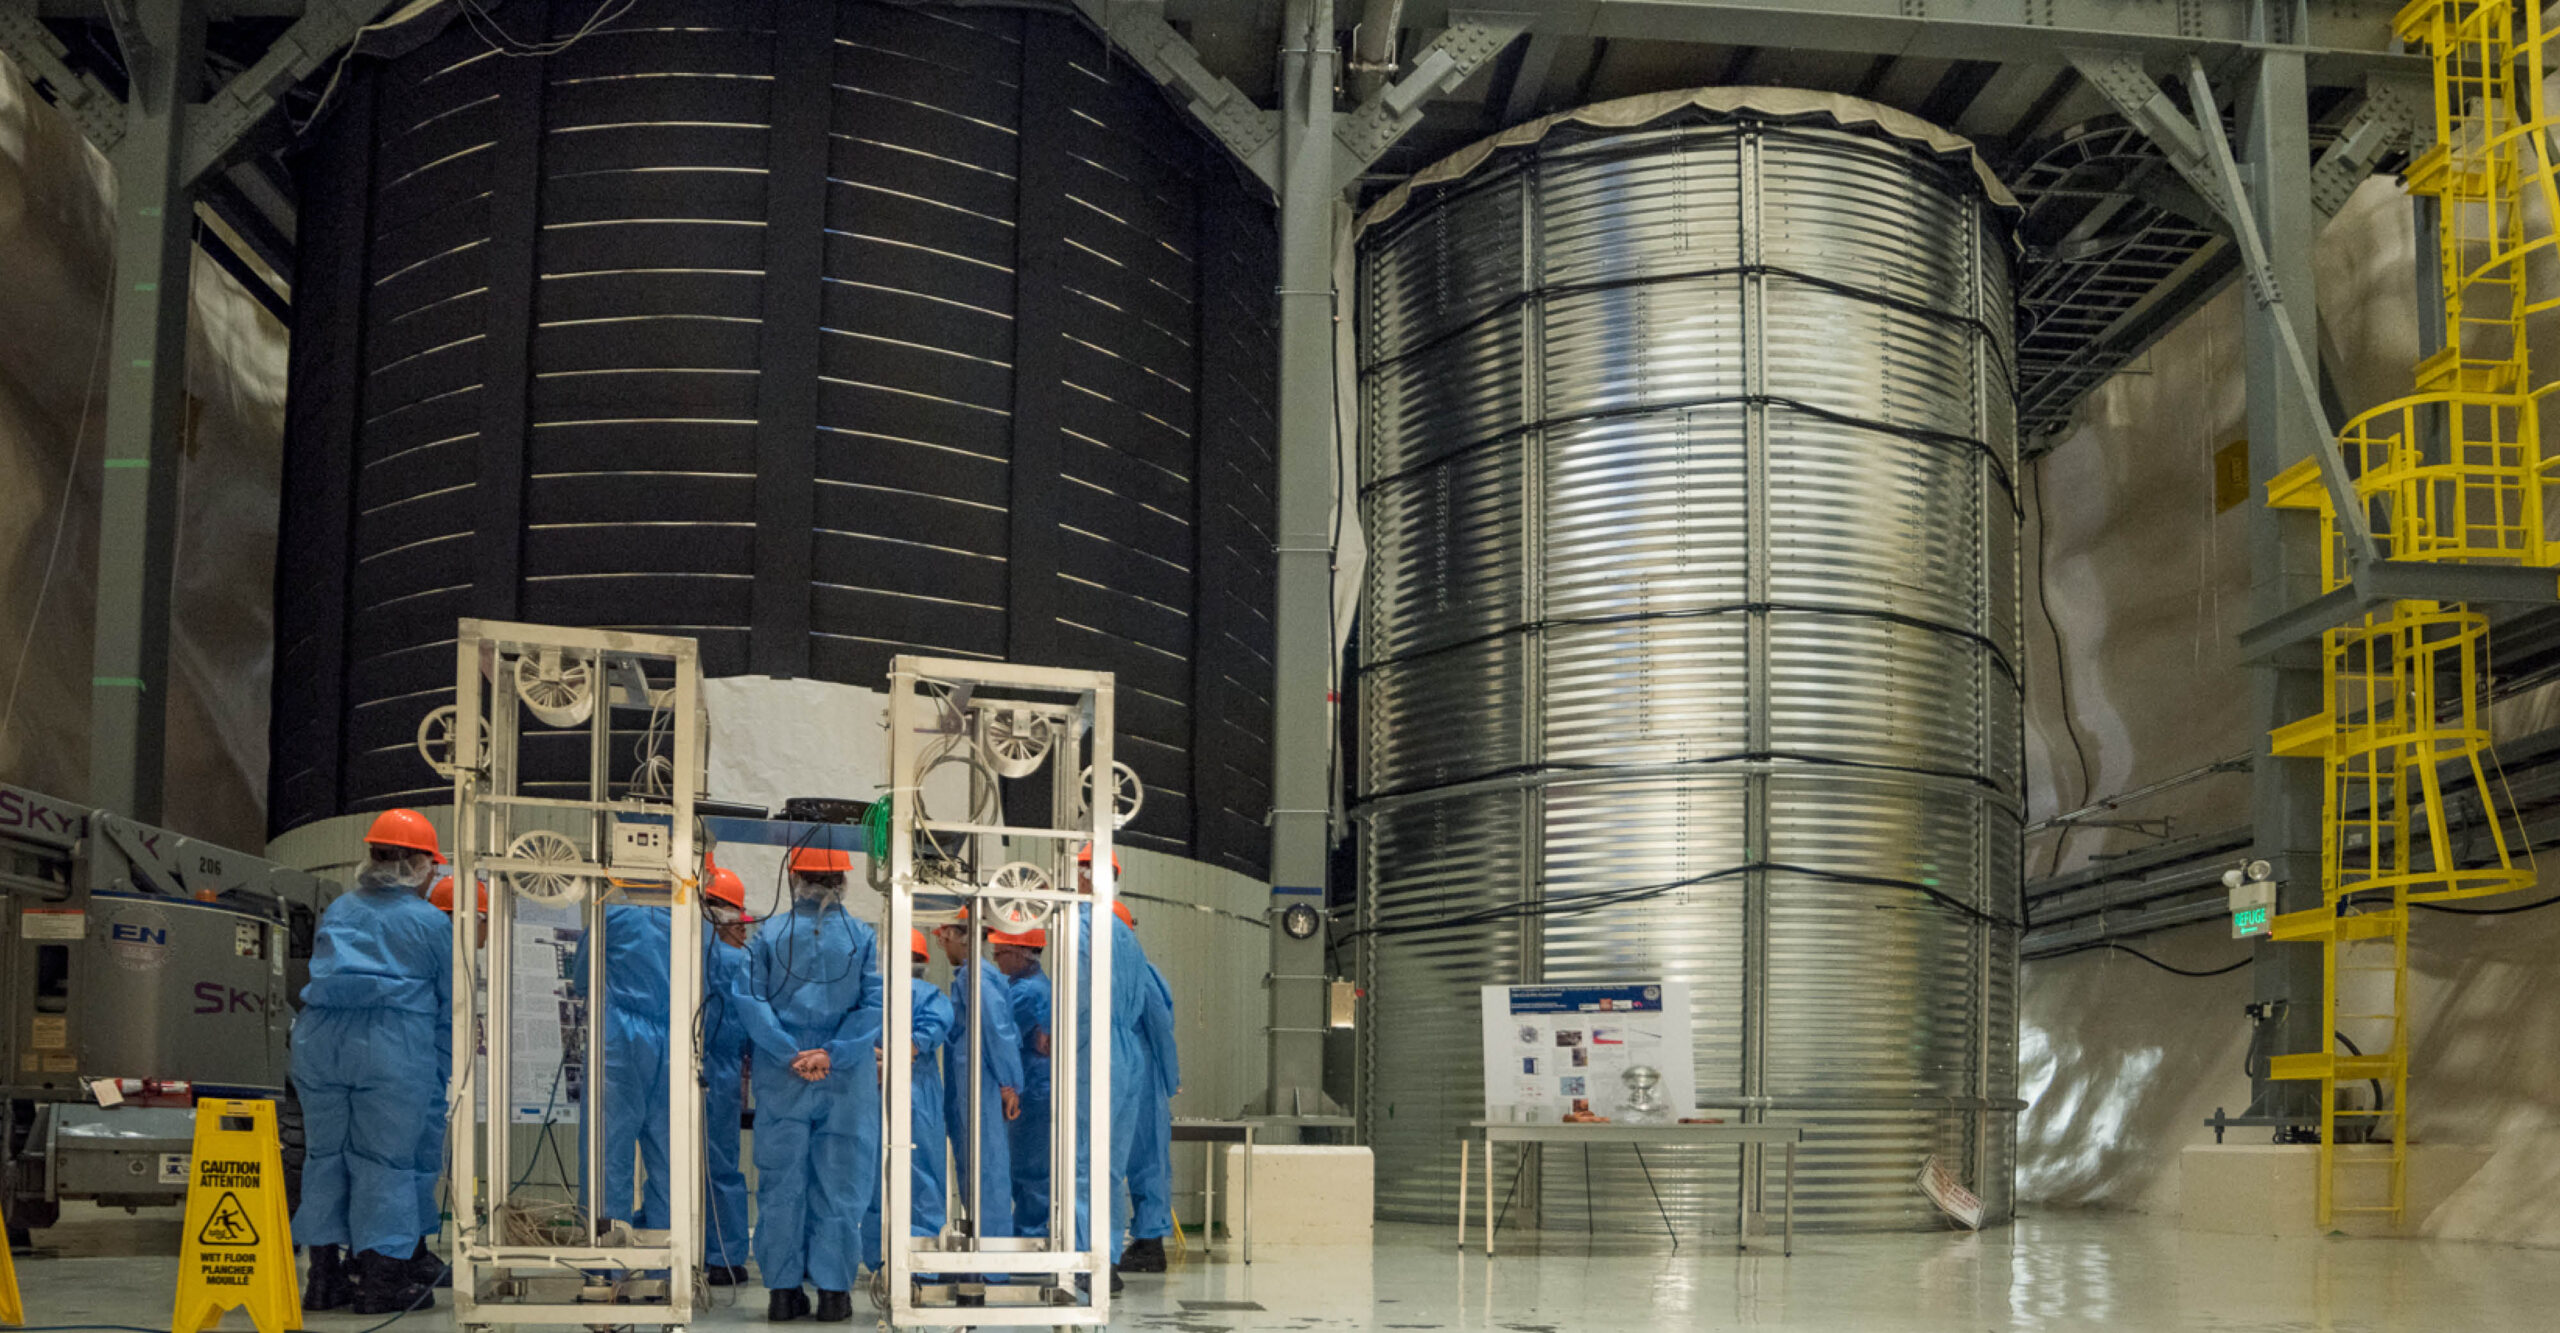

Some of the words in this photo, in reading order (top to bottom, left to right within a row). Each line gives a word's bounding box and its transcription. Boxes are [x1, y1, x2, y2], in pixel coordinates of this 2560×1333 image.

[199, 856, 222, 876] 206
[2234, 908, 2266, 926] REFUGE
[112, 923, 166, 945] EN
[200, 1160, 261, 1175] CAUTION
[200, 1175, 260, 1189] ATTENTION
[200, 1252, 221, 1263] WET
[224, 1253, 256, 1264] FLOOR
[201, 1264, 254, 1276] PLANCHER
[206, 1274, 249, 1286] MOUILLÉ
